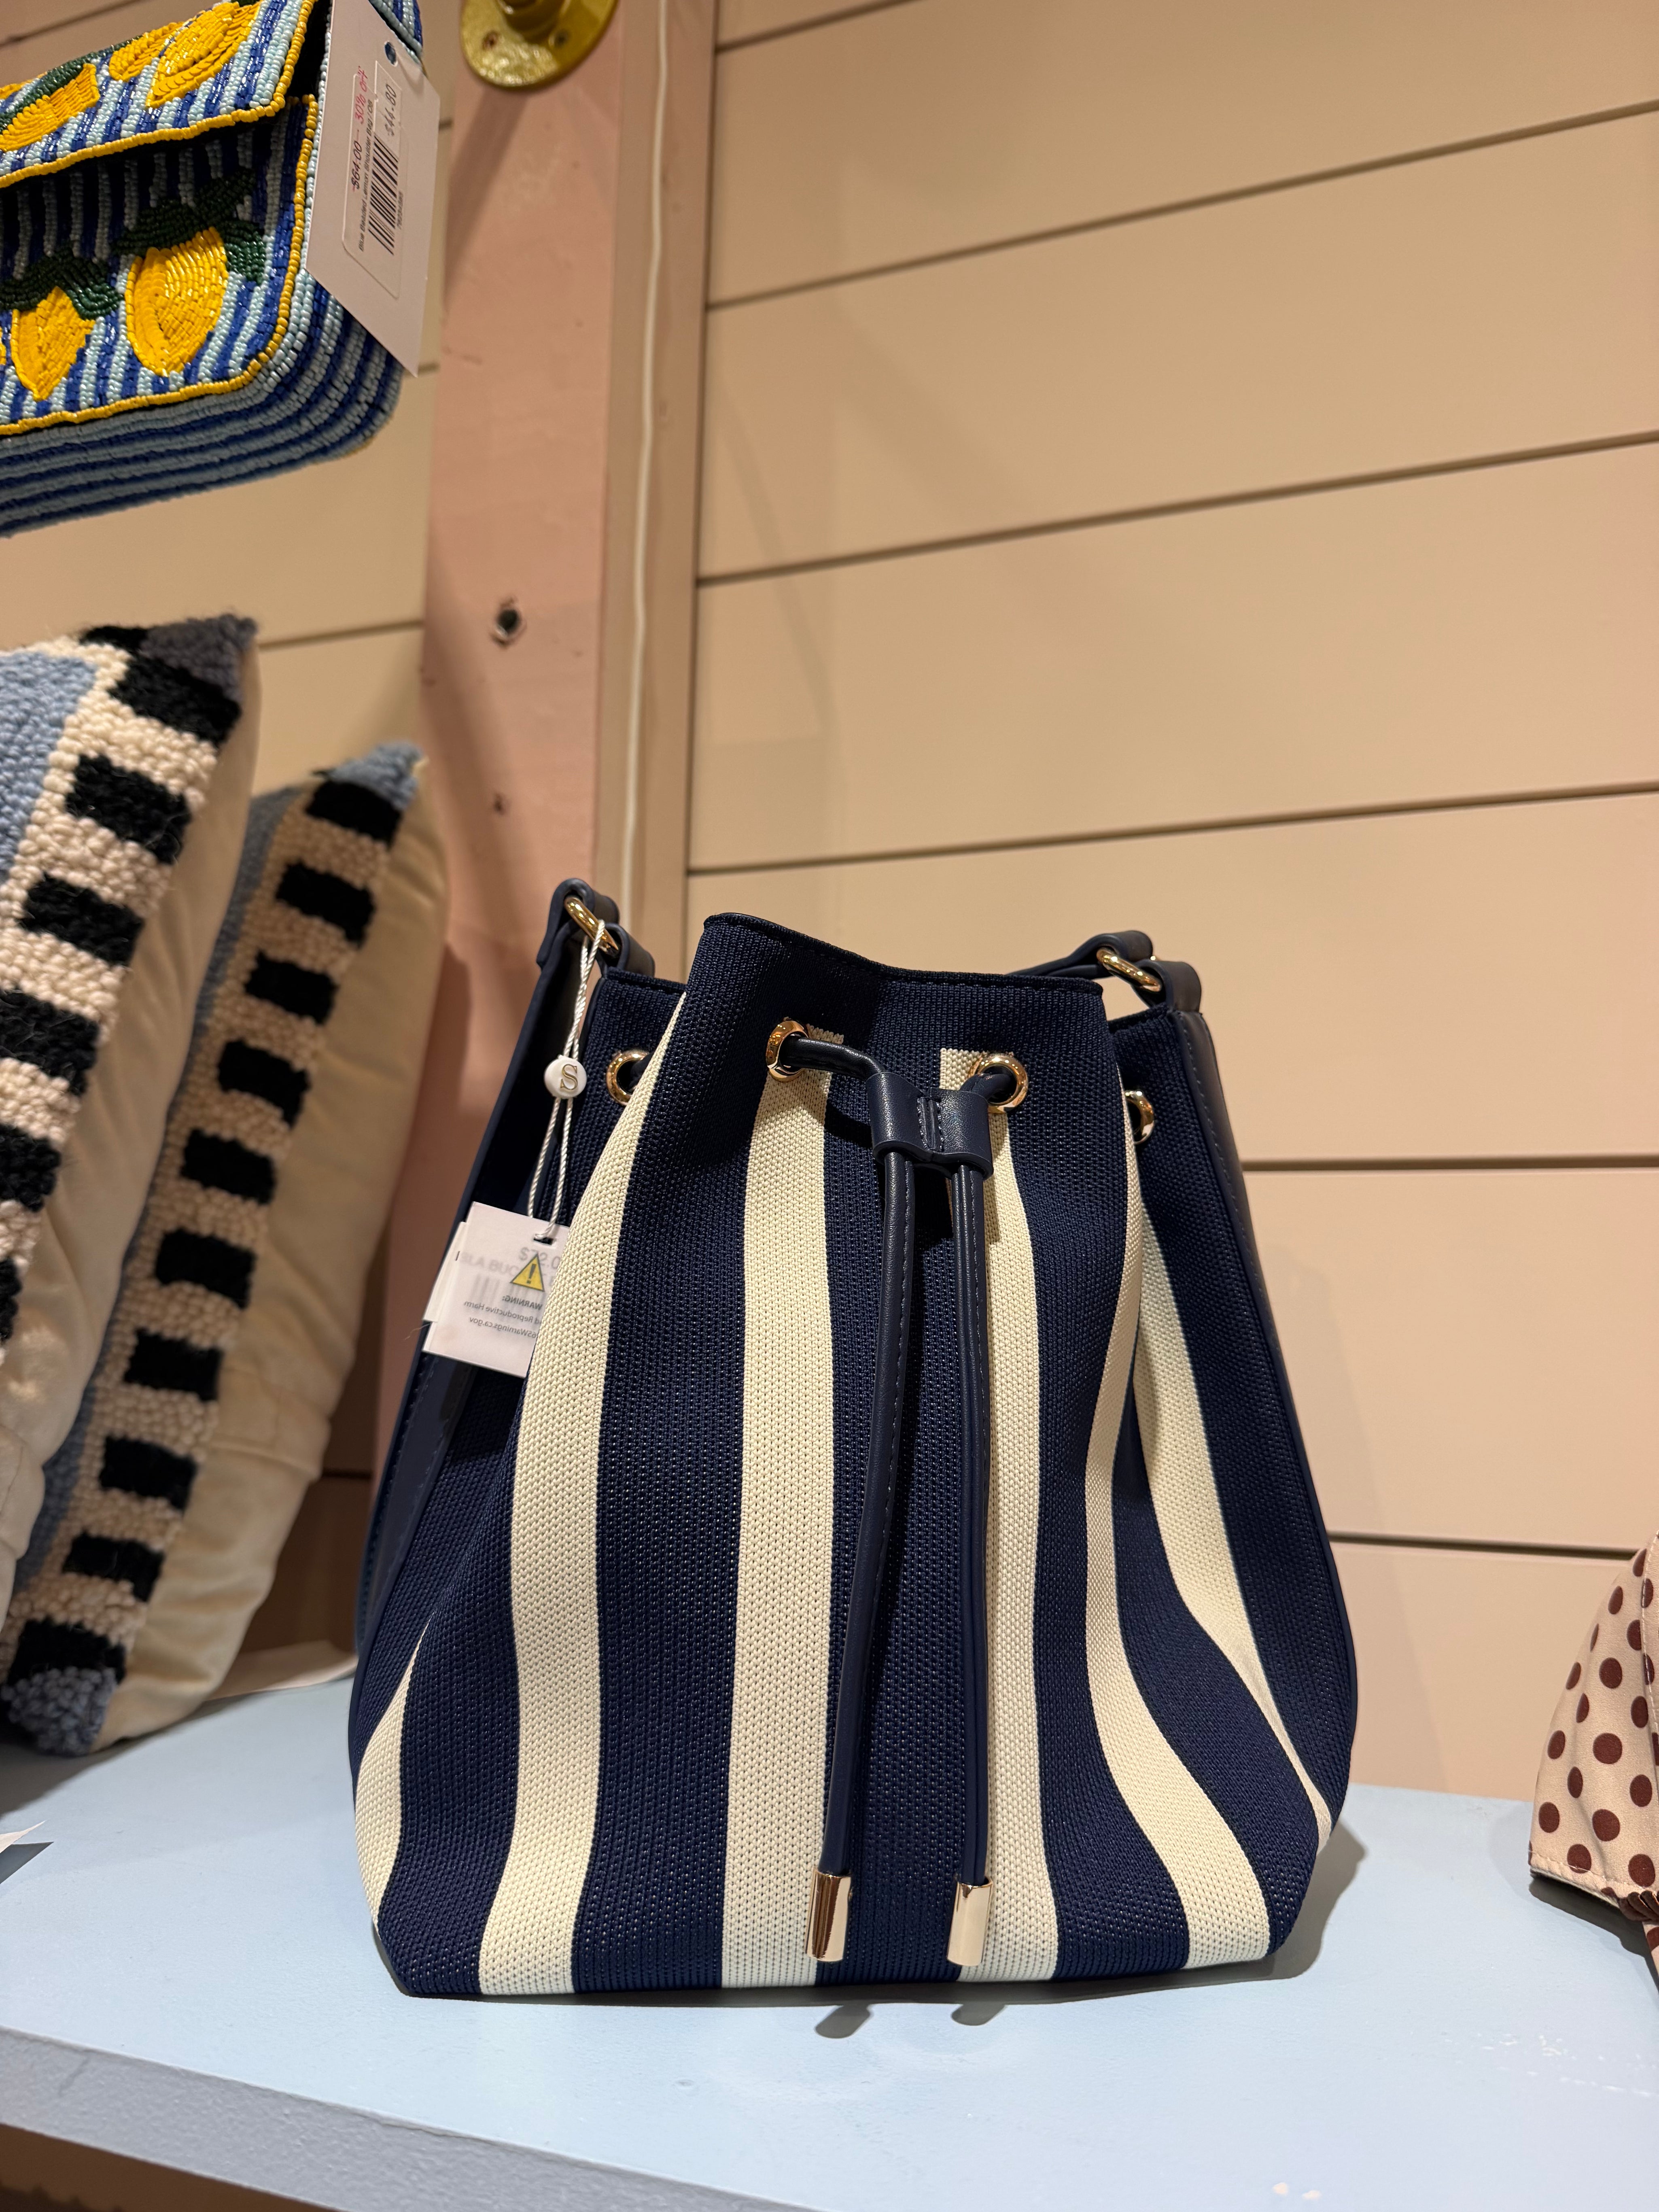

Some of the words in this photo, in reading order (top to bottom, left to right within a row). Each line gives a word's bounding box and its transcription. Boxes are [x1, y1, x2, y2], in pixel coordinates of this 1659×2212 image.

[355, 94, 366, 125] 30%
[384, 83, 396, 136] $44.80
[351, 140, 362, 190] $64.00
[560, 1064, 578, 1090] S
